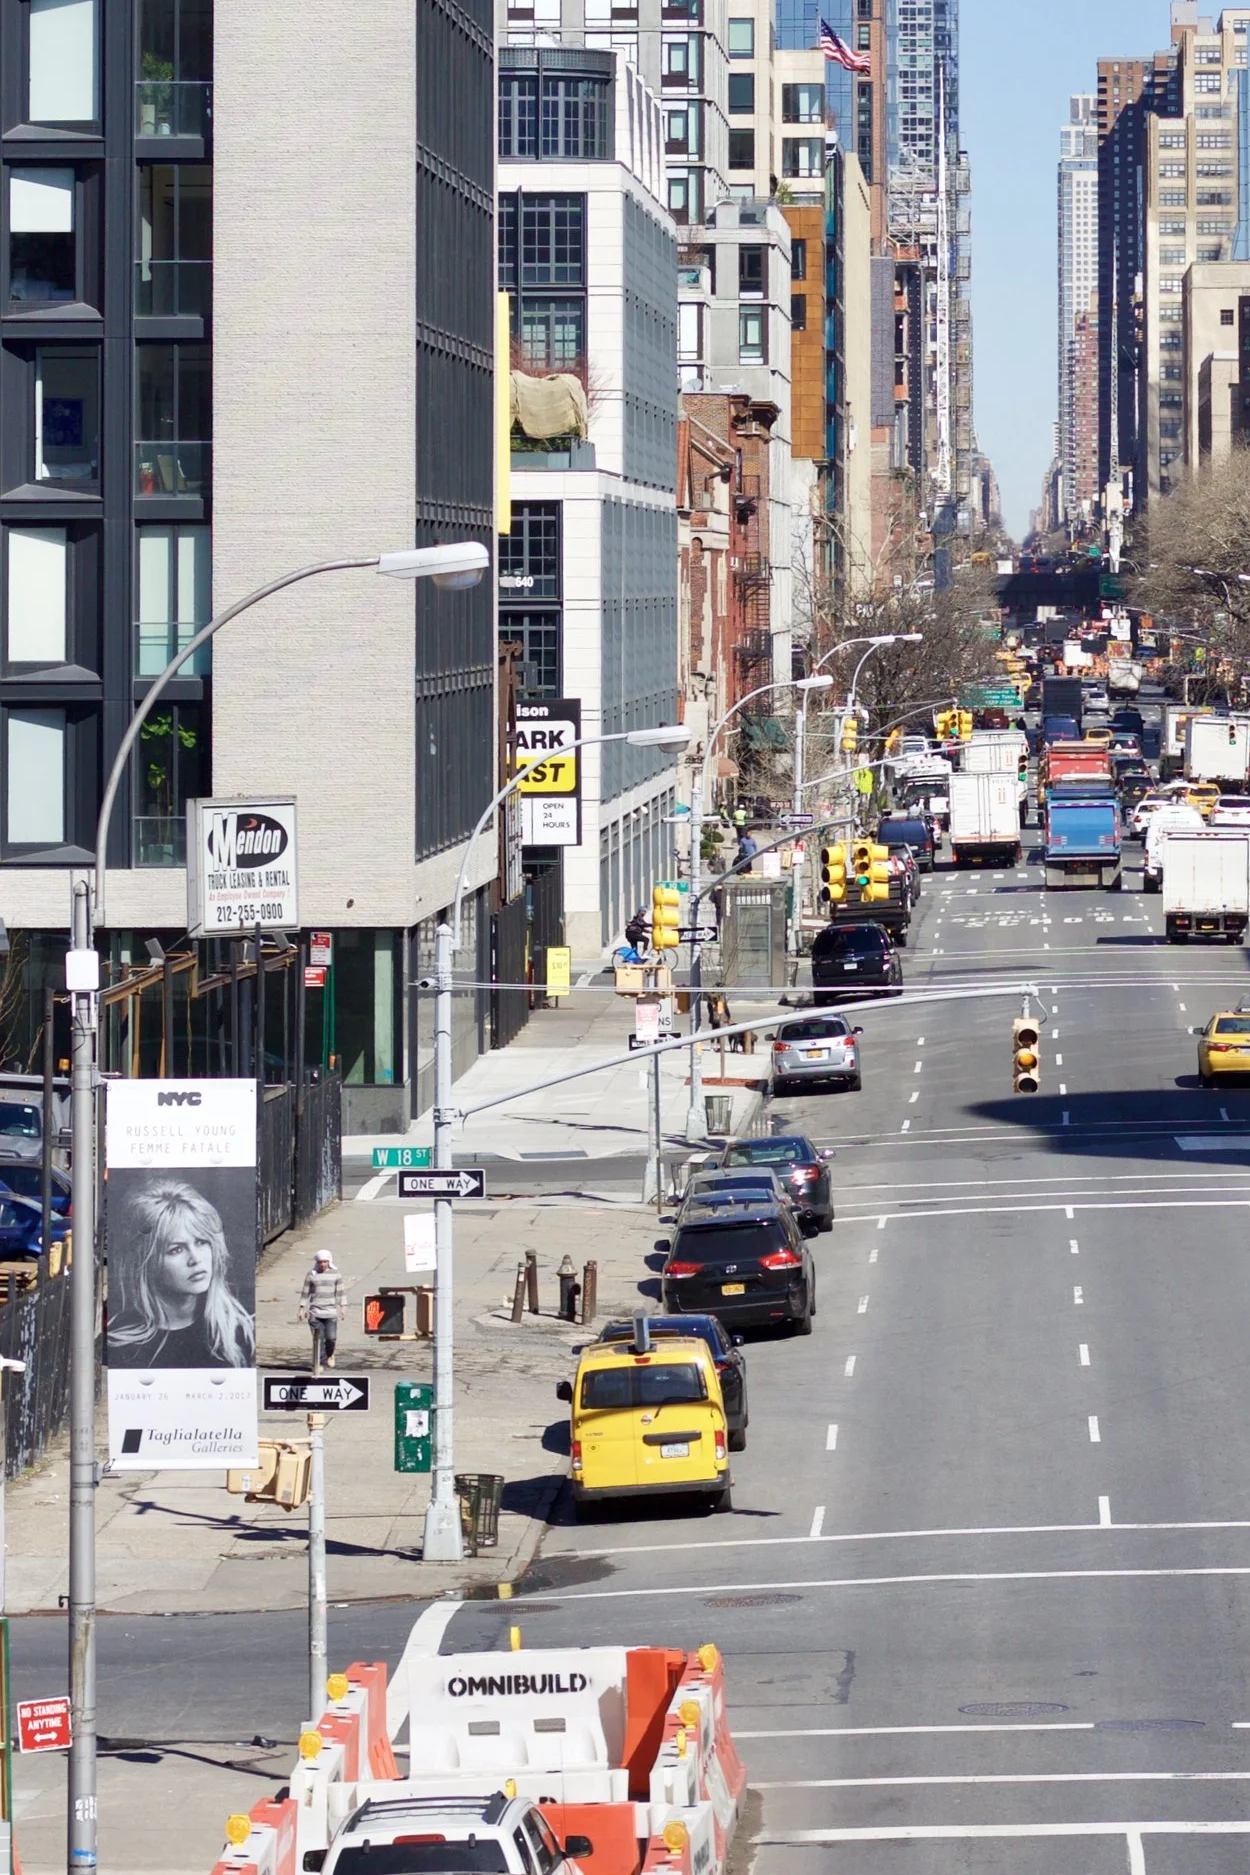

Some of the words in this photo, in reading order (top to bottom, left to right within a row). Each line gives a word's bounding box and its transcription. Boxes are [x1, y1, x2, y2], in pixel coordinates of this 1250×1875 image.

[515, 576, 534, 588] 640
[212, 812, 281, 872] Mendon
[208, 873, 227, 890] TRUCK
[229, 872, 256, 889] LEASING
[265, 870, 290, 887] RENTAL
[216, 903, 283, 922] 212-255-0900
[157, 1091, 202, 1107] NYC
[126, 1125, 184, 1137] RUSSELL
[195, 1125, 236, 1136] YOUNG
[131, 1143, 171, 1154] FEMME
[182, 1142, 231, 1153] FATALE
[377, 1150, 389, 1165] W
[397, 1149, 412, 1165] 18
[416, 1149, 427, 1158] ST
[411, 1179, 435, 1189] ONE
[446, 1179, 471, 1189] WAY
[114, 1393, 151, 1401] JANUARY
[185, 1392, 213, 1400] MARCH
[279, 1387, 308, 1401] ONE
[323, 1387, 353, 1401] WAY
[147, 1428, 243, 1445] Taglialatella
[191, 1442, 243, 1453] Galleries
[448, 1673, 587, 1697] OMNIBUILD
[21, 1706, 32, 1719] NO
[33, 1703, 67, 1717] STANDING
[27, 1717, 62, 1731] ANYTIME
